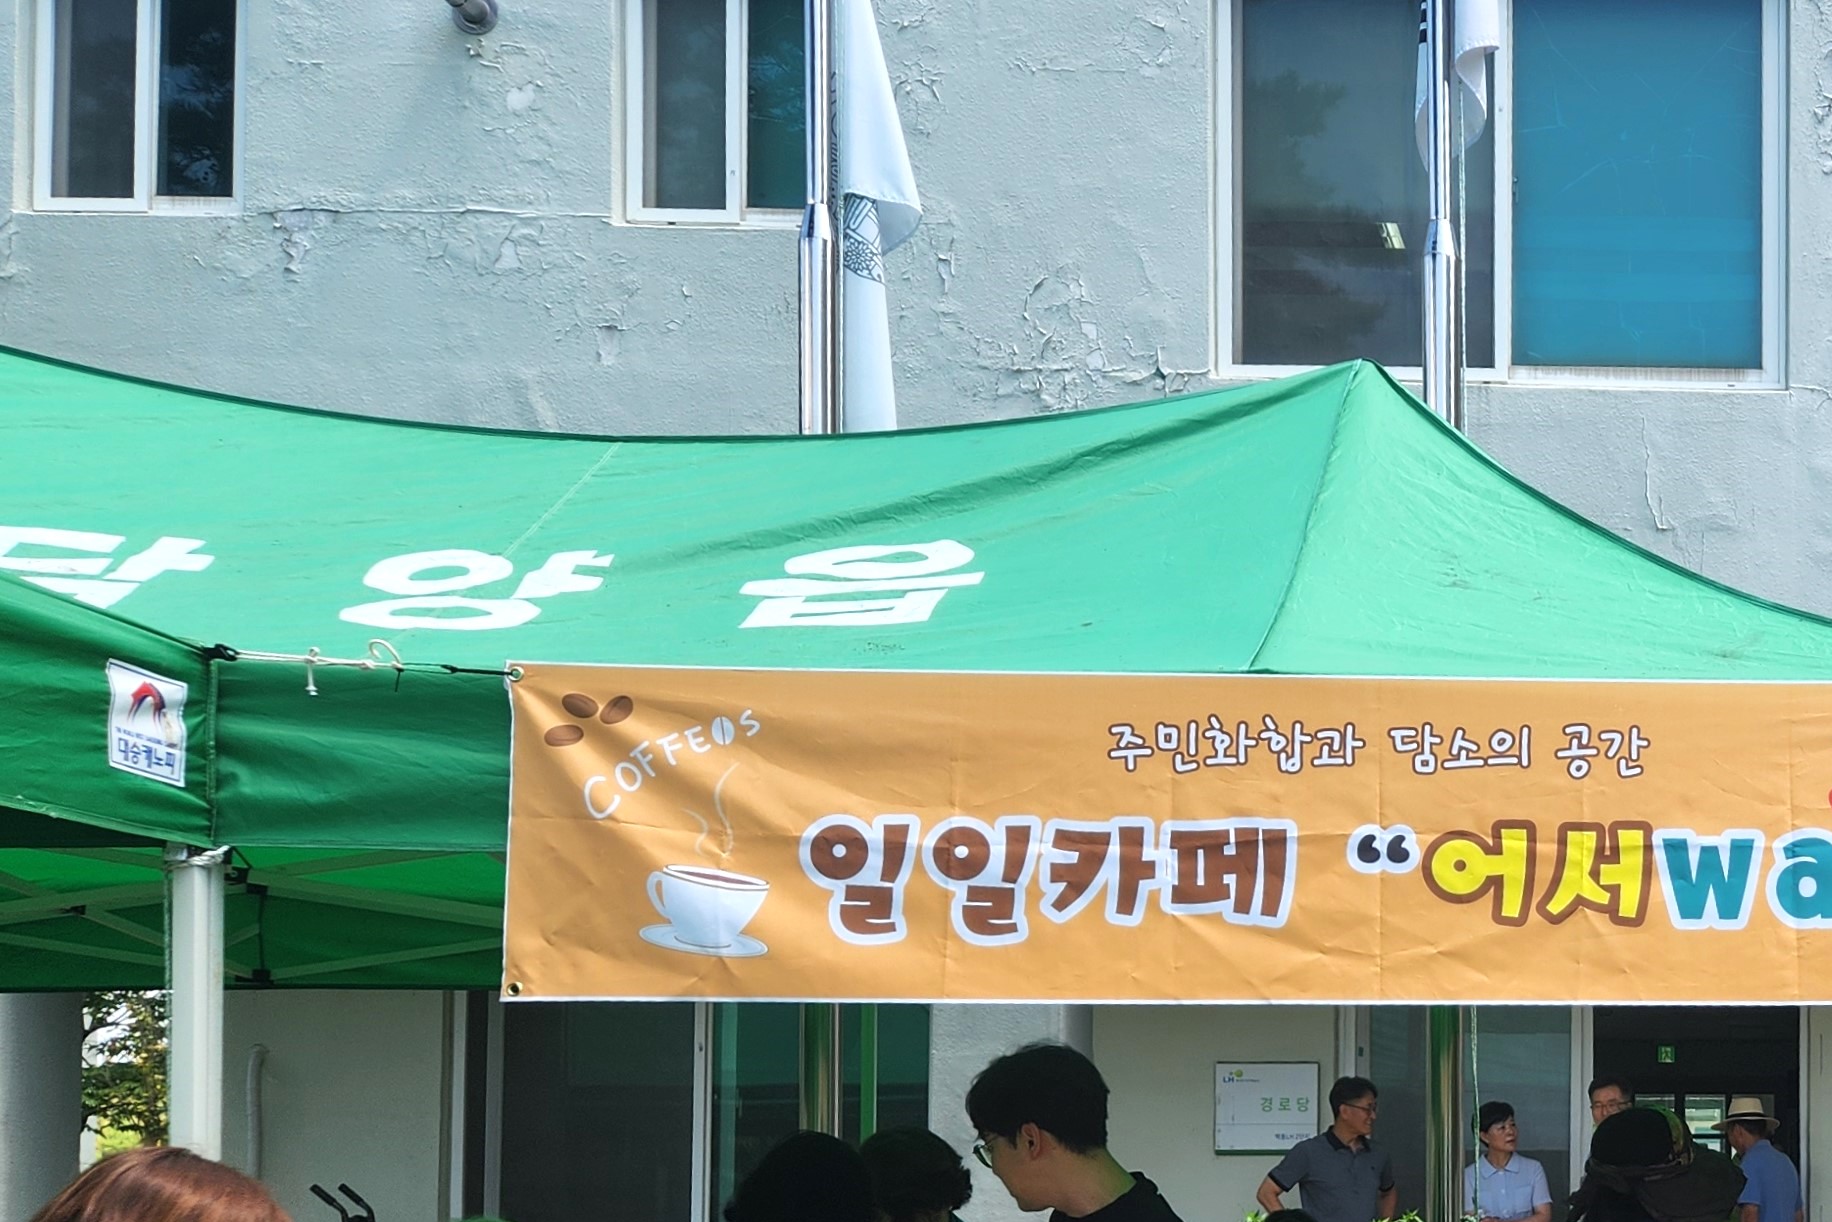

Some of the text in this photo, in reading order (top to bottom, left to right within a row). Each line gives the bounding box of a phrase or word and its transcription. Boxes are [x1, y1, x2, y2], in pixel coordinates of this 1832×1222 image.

[1108, 714, 1650, 780] 주민화합과 담소의 공간
[800, 814, 1298, 946] 일일카페
[1260, 1097, 1310, 1112] 경로당
